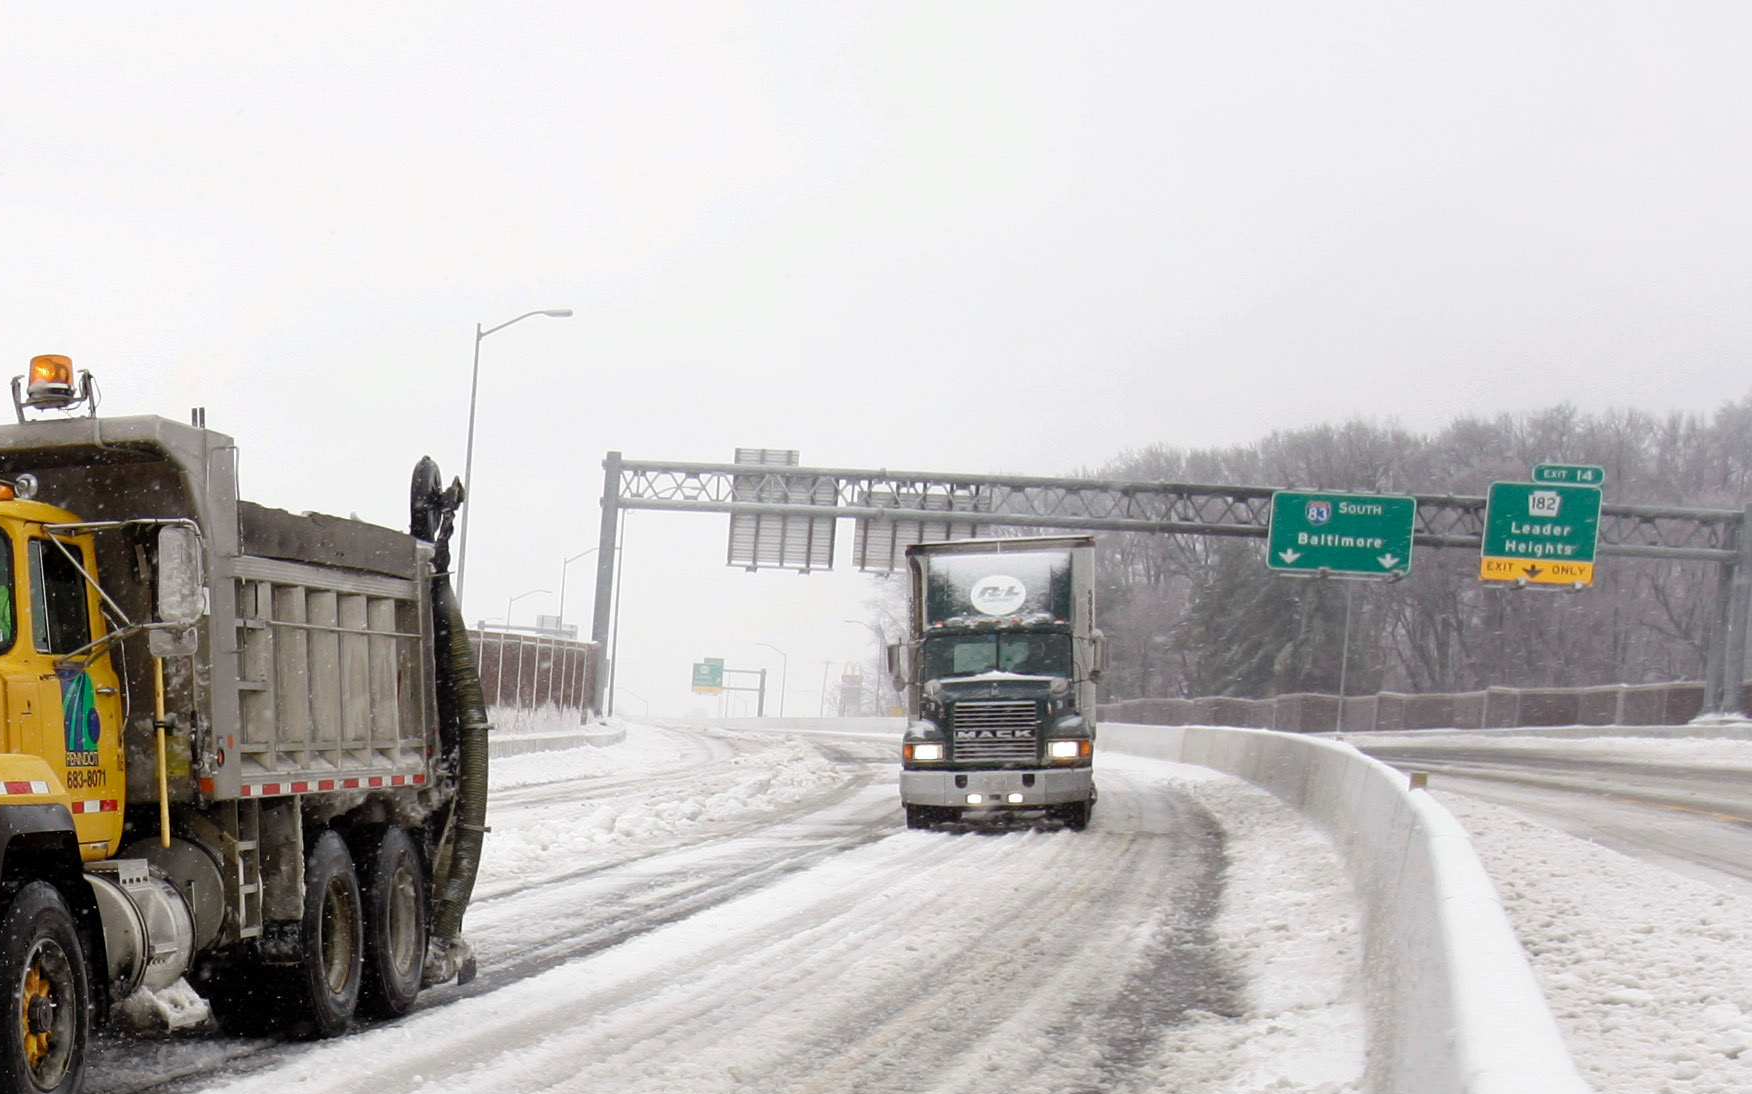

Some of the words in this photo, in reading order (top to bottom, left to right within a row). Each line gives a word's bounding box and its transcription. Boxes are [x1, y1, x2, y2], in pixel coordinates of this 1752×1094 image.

[1543, 469, 1567, 479] EXIT
[1576, 470, 1593, 481] 14
[1308, 506, 1328, 520] 83
[1338, 501, 1382, 515] SOUTH
[1531, 497, 1556, 511] 182
[1511, 521, 1570, 536] Leader
[1297, 532, 1383, 548] Baltimore
[1505, 540, 1573, 557] Heights
[1486, 561, 1514, 572] EXIT
[1551, 565, 1586, 576] ONLY
[957, 729, 1032, 739] MACK
[67, 769, 106, 789] 683-8071
